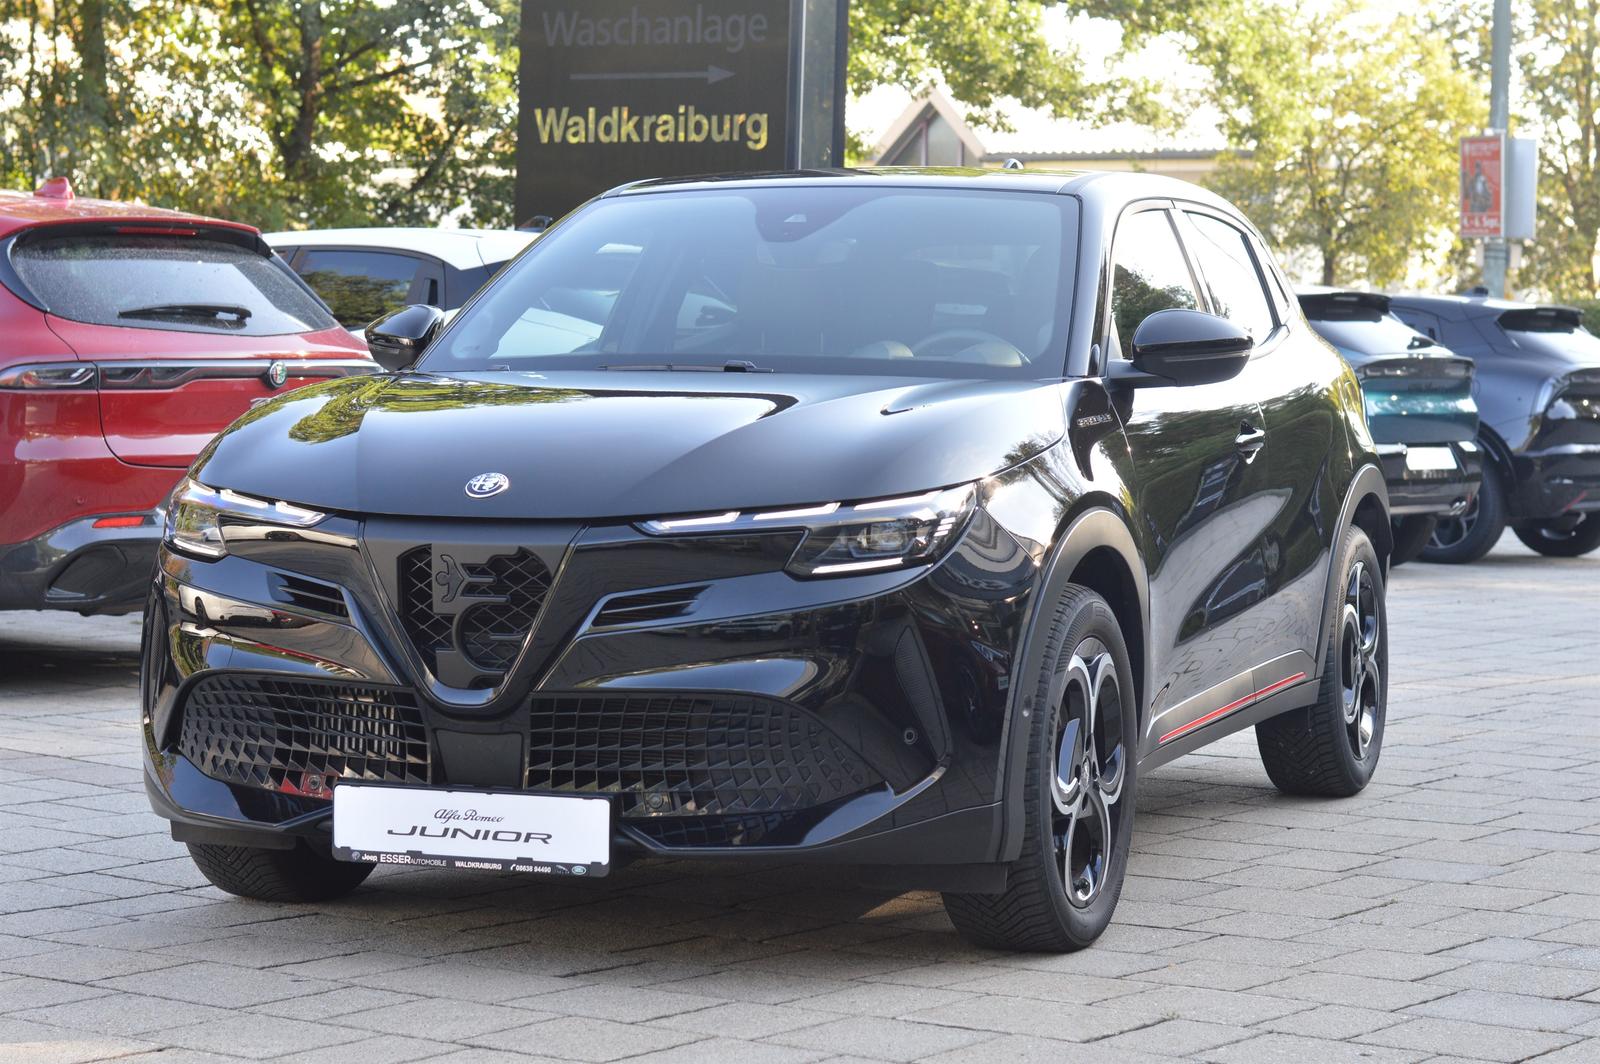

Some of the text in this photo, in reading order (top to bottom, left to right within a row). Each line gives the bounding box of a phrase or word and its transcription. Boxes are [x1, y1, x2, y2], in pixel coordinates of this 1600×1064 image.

[542, 4, 768, 52] Waschanlage
[534, 105, 769, 151] Waldkraiburg
[434, 808, 505, 824] Alfa Romeo
[387, 825, 553, 845] JUNIOR
[361, 853, 378, 862] Jeep
[454, 860, 502, 870] WALDKRAIBURG
